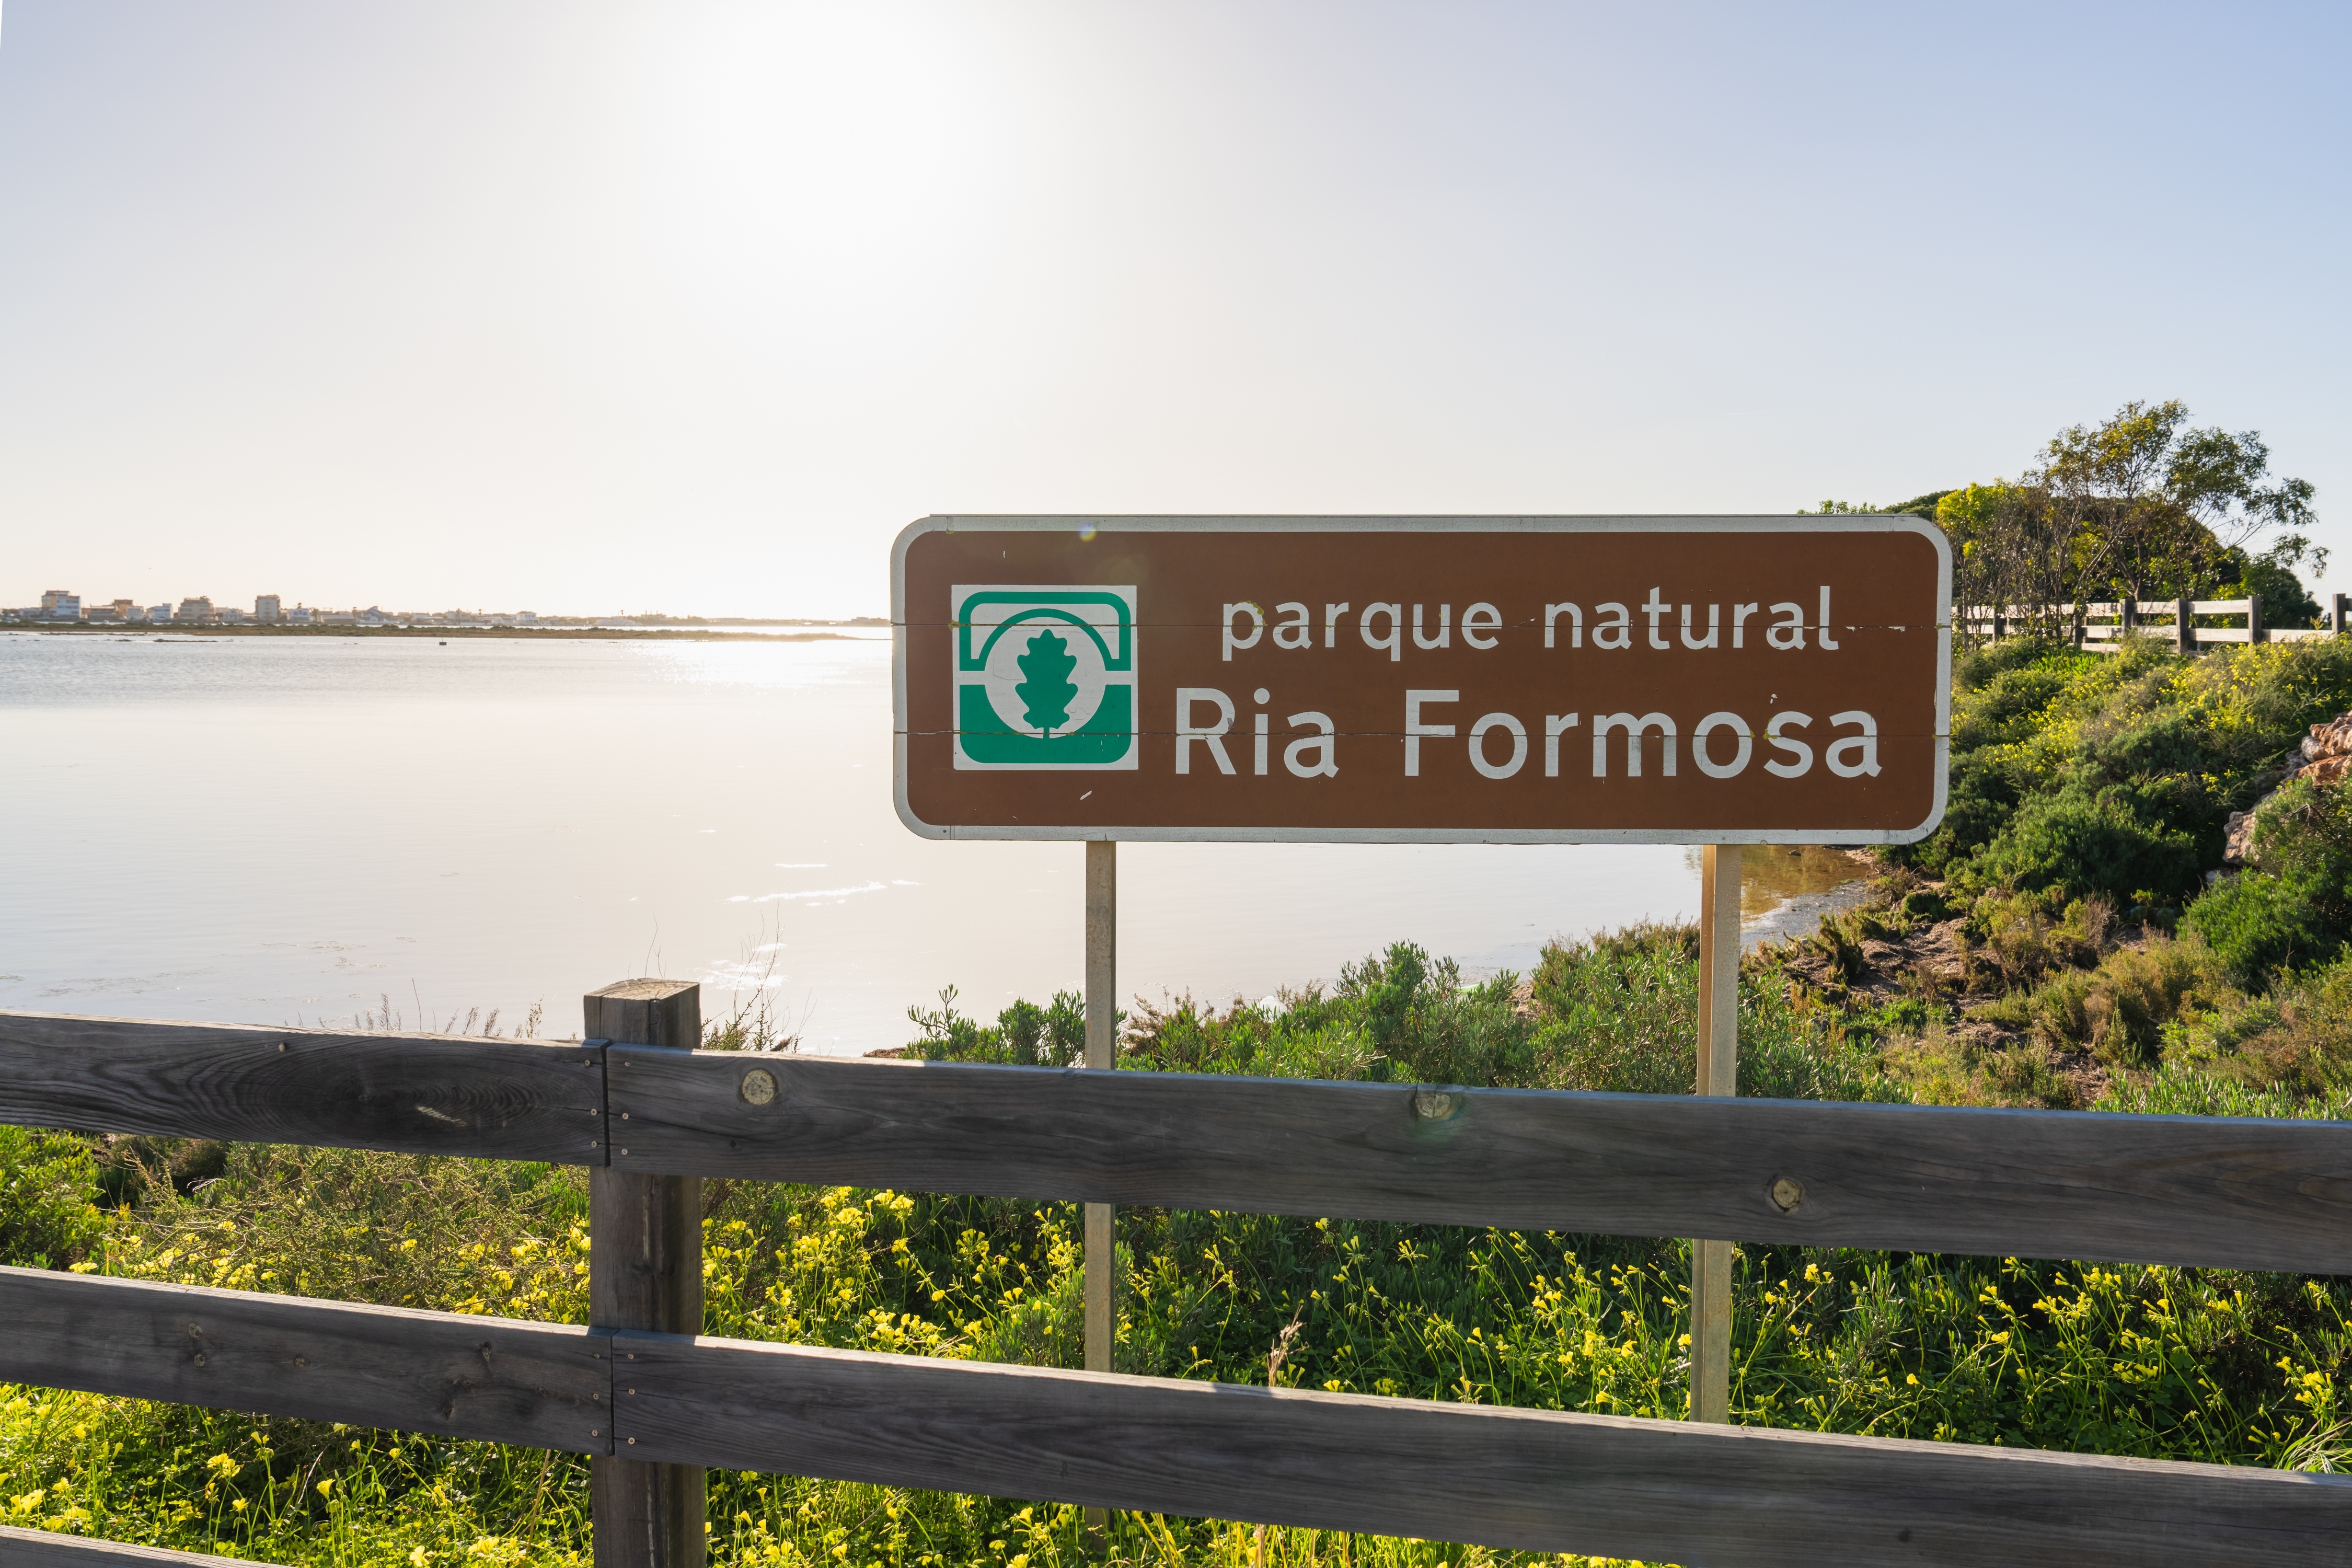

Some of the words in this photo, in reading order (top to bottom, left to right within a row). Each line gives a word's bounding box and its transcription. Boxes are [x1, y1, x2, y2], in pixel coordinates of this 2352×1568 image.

[1221, 602, 1503, 662] parque
[1544, 585, 1839, 650] natural
[1175, 687, 1340, 778] Ria
[1405, 689, 1882, 779] Formosa
